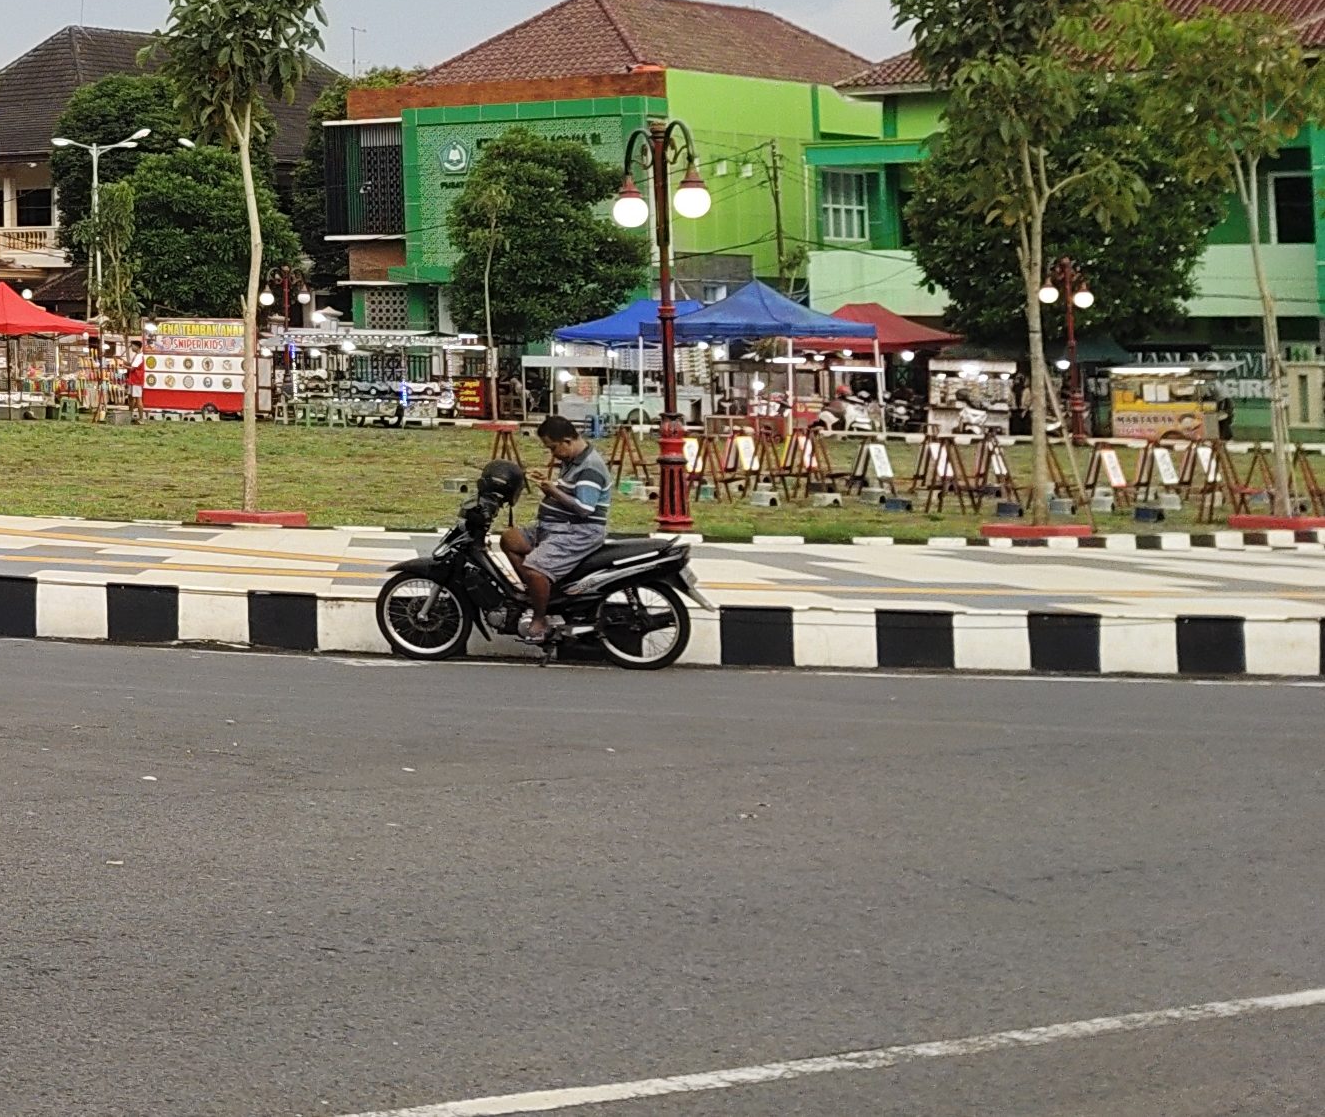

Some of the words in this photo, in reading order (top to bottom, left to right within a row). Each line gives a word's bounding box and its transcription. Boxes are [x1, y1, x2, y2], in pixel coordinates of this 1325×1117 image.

[157, 323, 180, 335] RENA
[182, 324, 219, 336] TEMBAK
[173, 338, 202, 350] SNIPER
[203, 338, 224, 350] KIDS
